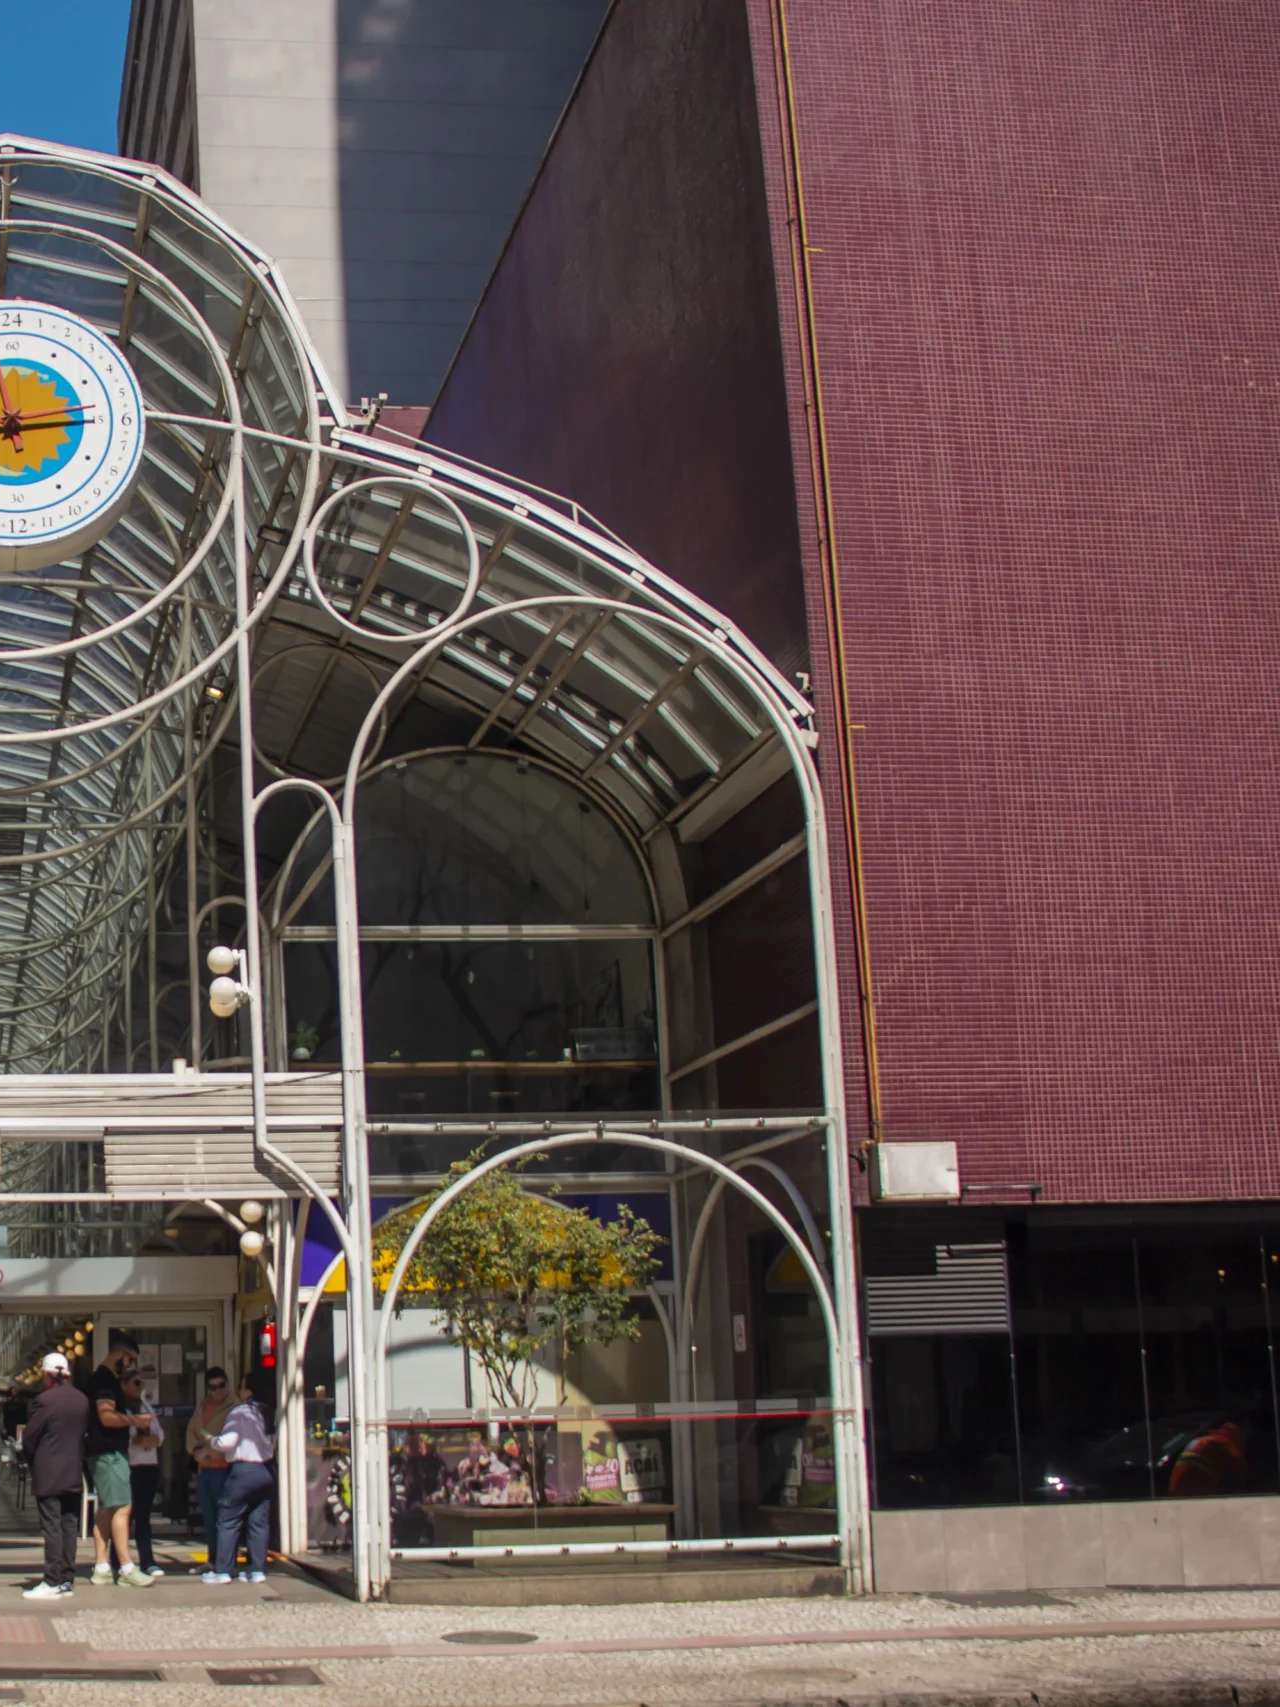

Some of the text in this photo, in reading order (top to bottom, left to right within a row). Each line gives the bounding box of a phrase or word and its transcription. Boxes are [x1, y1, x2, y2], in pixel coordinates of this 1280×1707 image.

[1, 312, 23, 328] 24
[37, 318, 44, 328] 1
[63, 327, 72, 338] 2
[5, 340, 20, 351] 60
[87, 342, 96, 353] 3
[105, 363, 114, 374] 4
[118, 387, 127, 398] 5
[120, 412, 133, 427] 6
[119, 440, 128, 451] 7
[109, 465, 119, 477] 8
[92, 487, 102, 498] 9
[9, 493, 26, 504] 30
[67, 504, 82, 516] 10
[8, 518, 29, 534] 12
[40, 516, 54, 528] 11
